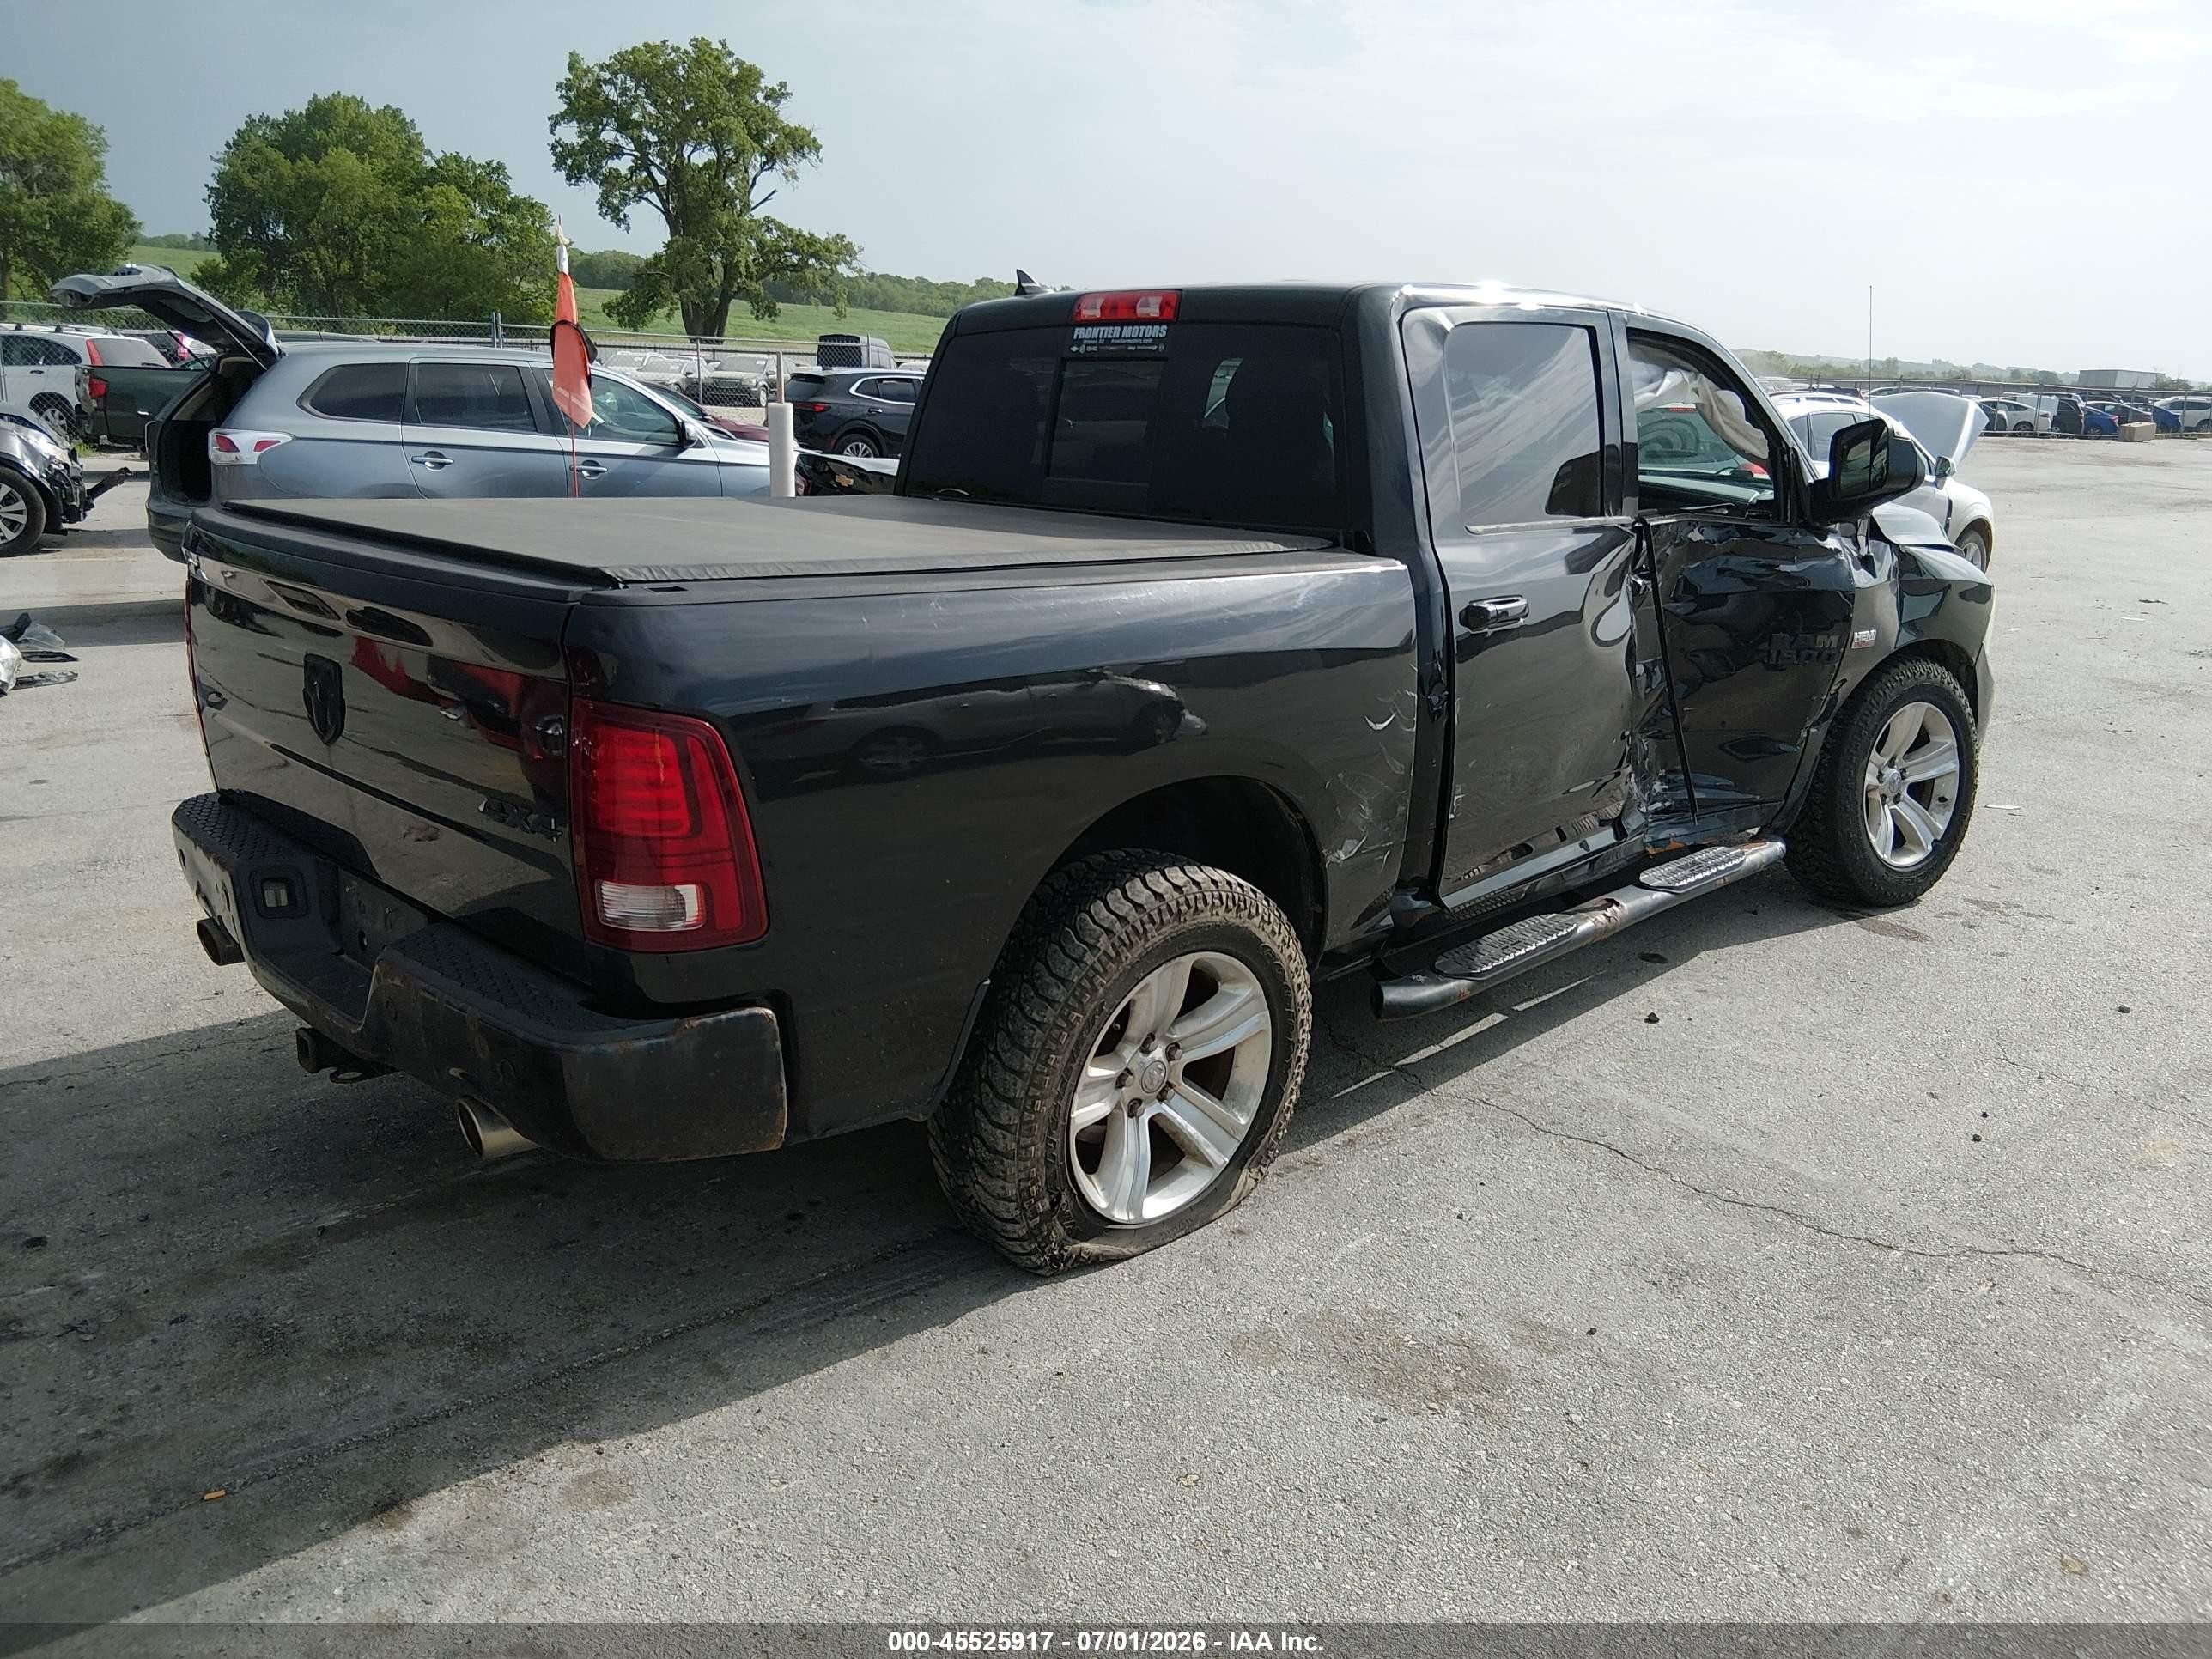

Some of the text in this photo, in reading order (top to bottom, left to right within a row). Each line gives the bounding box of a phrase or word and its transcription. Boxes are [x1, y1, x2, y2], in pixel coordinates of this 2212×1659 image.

[1073, 325, 1168, 339] FRONTIER MOTORS
[1771, 633, 1839, 648] RAM
[1854, 629, 1877, 642] HEMI
